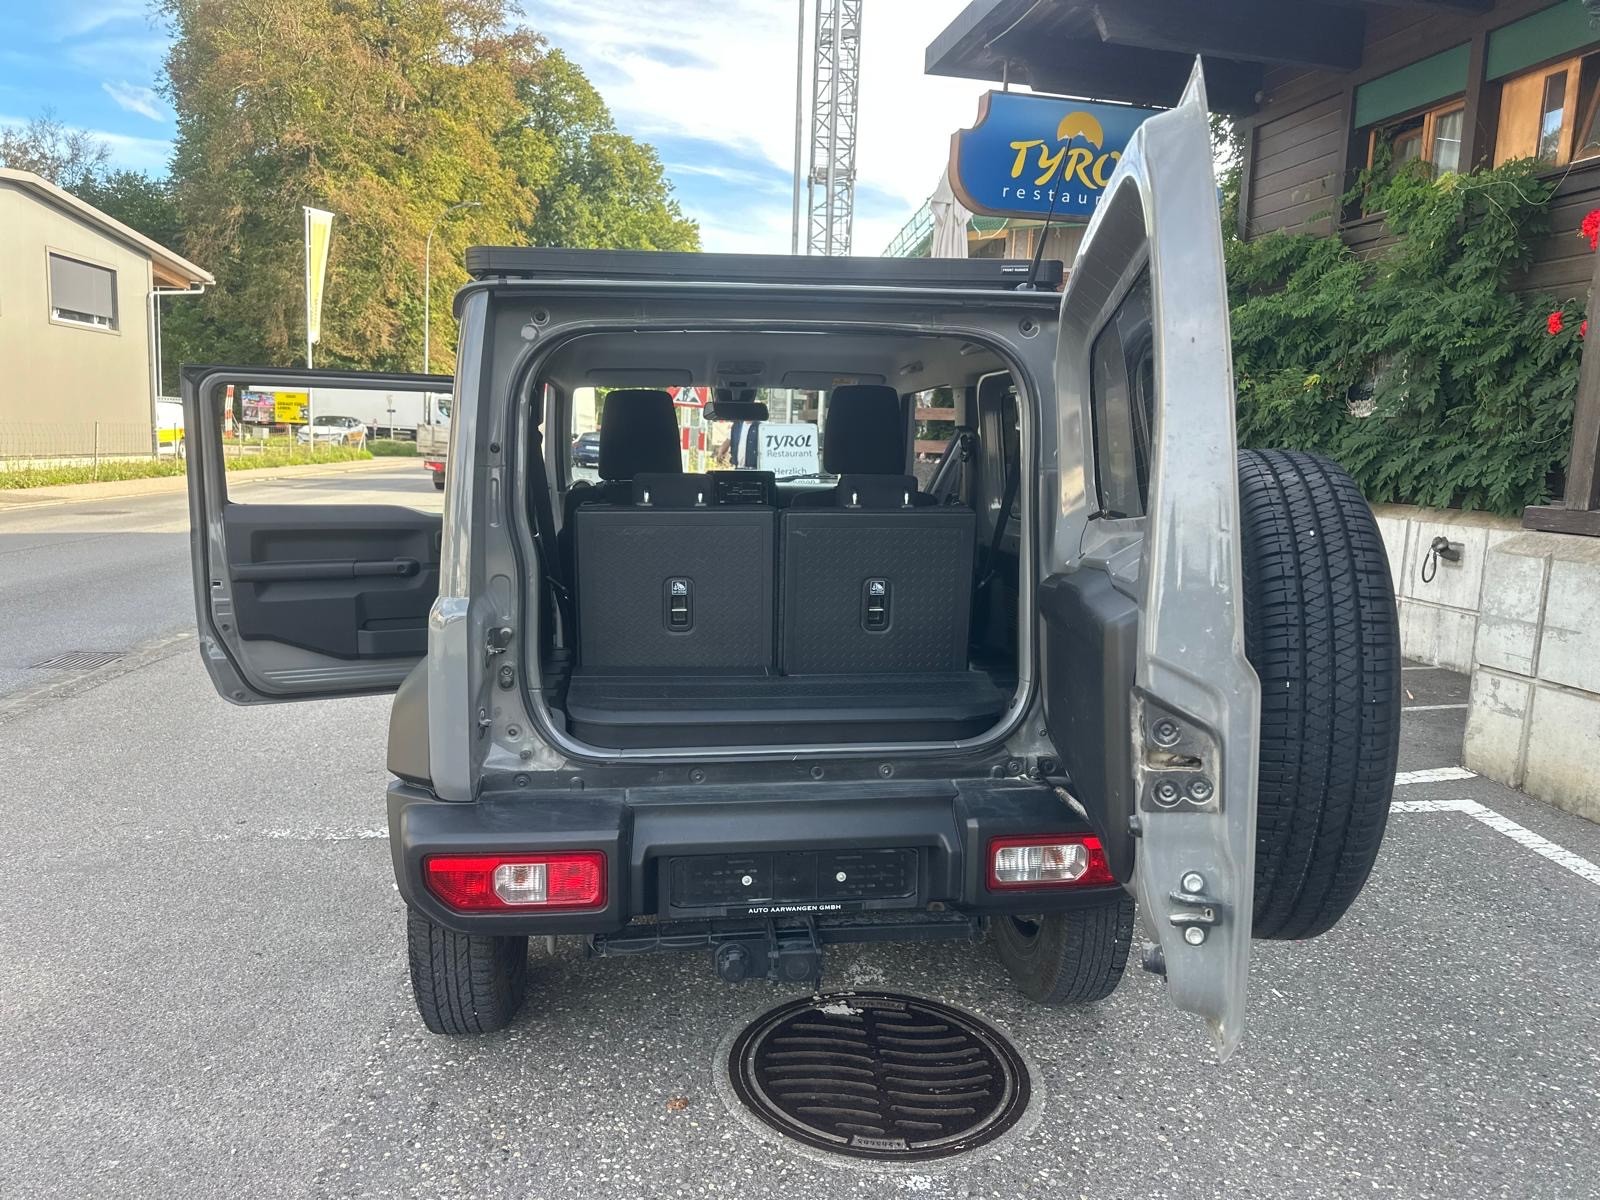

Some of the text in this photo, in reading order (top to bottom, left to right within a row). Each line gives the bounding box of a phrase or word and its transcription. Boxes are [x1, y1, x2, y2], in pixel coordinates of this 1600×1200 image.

[1010, 139, 1121, 190] TYRO
[1002, 186, 1102, 205] restaur
[765, 434, 812, 451] TYROL
[767, 449, 812, 458] Restaurant
[774, 466, 807, 475] Herzlich
[770, 905, 818, 913] AARWANGEN
